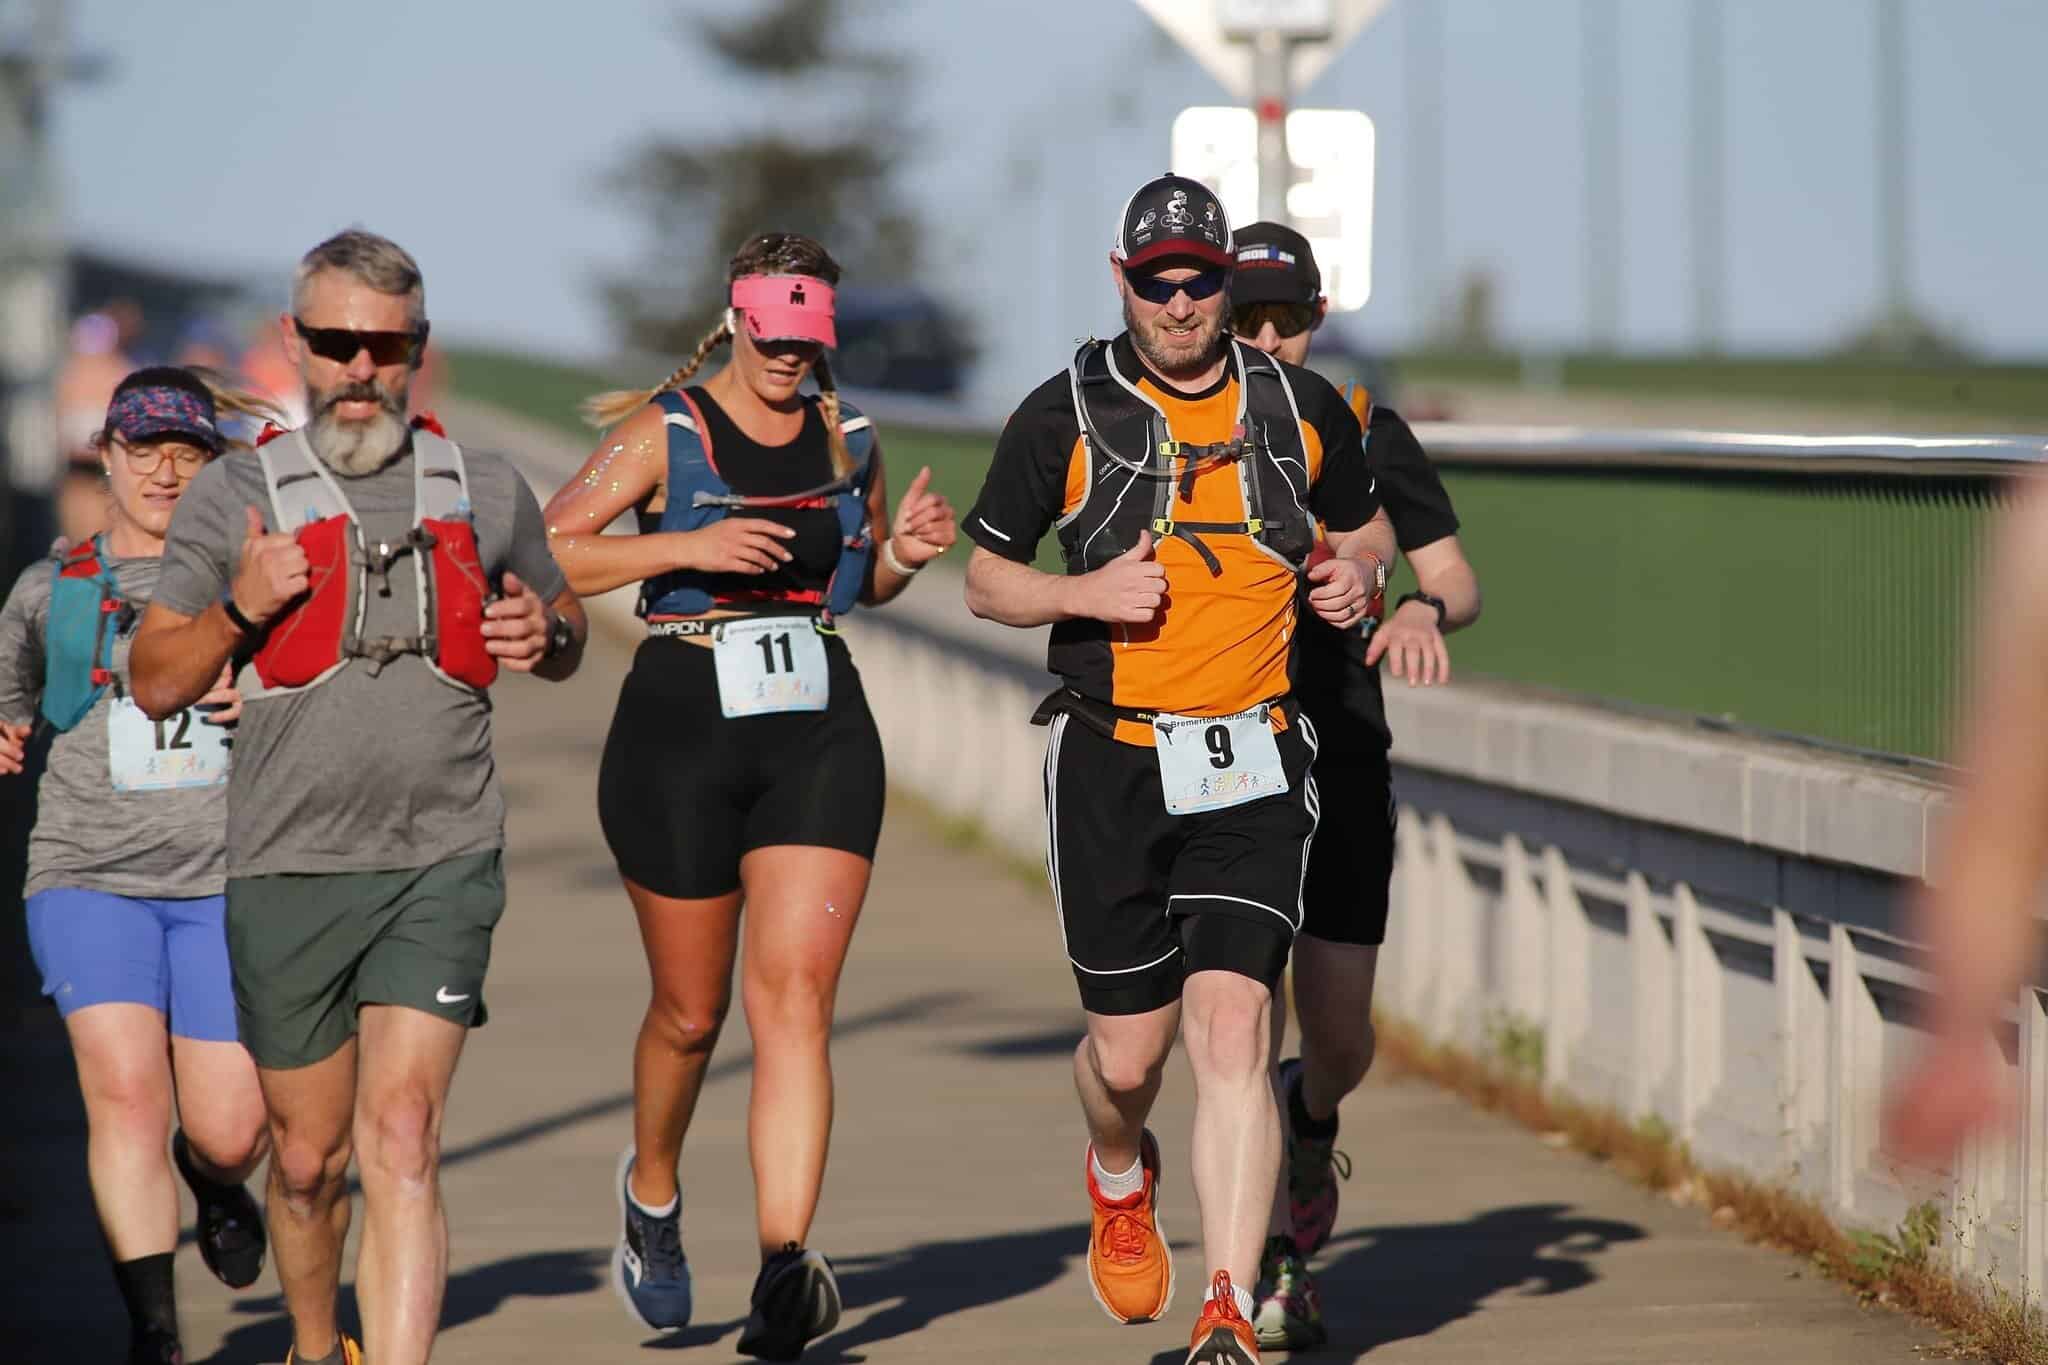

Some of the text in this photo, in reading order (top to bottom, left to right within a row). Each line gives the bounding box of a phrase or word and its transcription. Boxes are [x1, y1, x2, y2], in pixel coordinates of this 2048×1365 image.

[755, 632, 794, 674] 11
[155, 708, 192, 750] 12
[1171, 716, 1217, 728] Bremerton
[1205, 724, 1235, 769] 9
